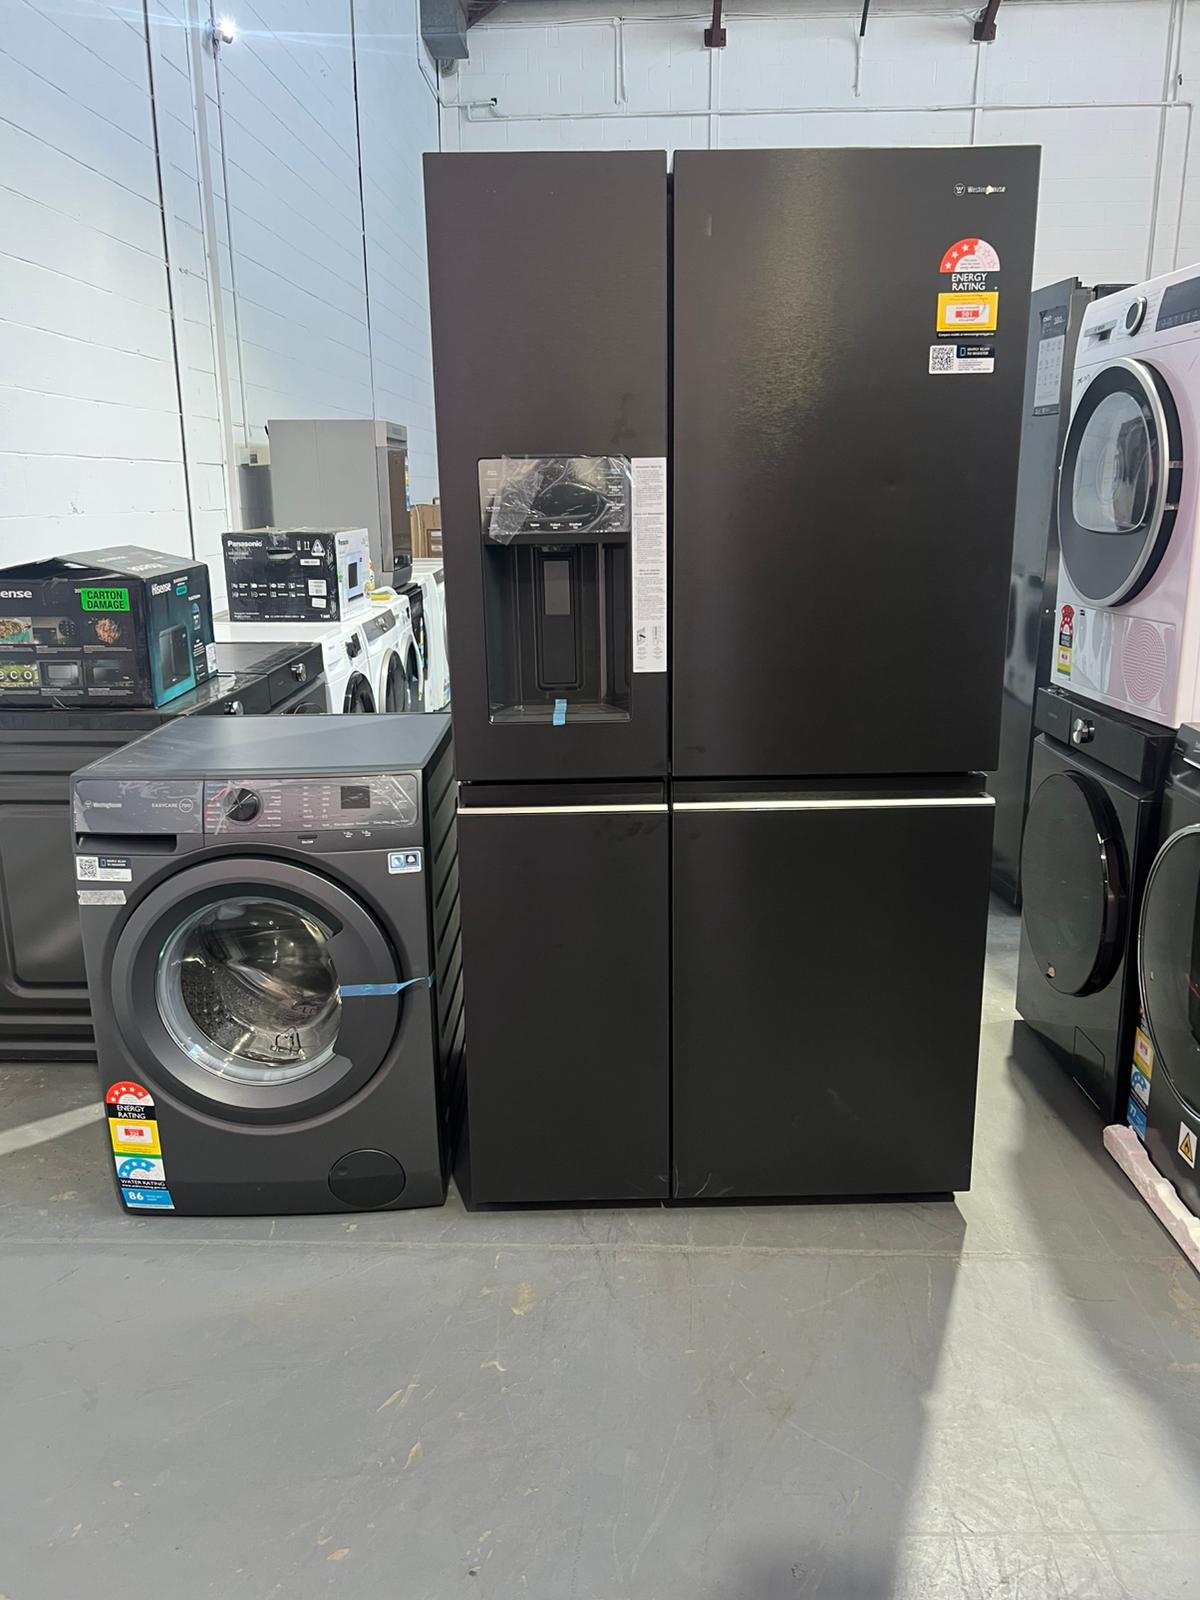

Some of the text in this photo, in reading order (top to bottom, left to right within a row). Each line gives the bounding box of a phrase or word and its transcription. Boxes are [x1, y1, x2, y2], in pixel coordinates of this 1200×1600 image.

[951, 272, 988, 283] ENERGY
[951, 281, 986, 292] RATING
[151, 582, 172, 596] Hisense
[87, 590, 123, 600] CARTON
[87, 600, 125, 610] DAMAGE
[116, 1104, 145, 1112] ENERGY
[117, 1112, 146, 1120] RATING
[128, 1191, 144, 1201] 86
